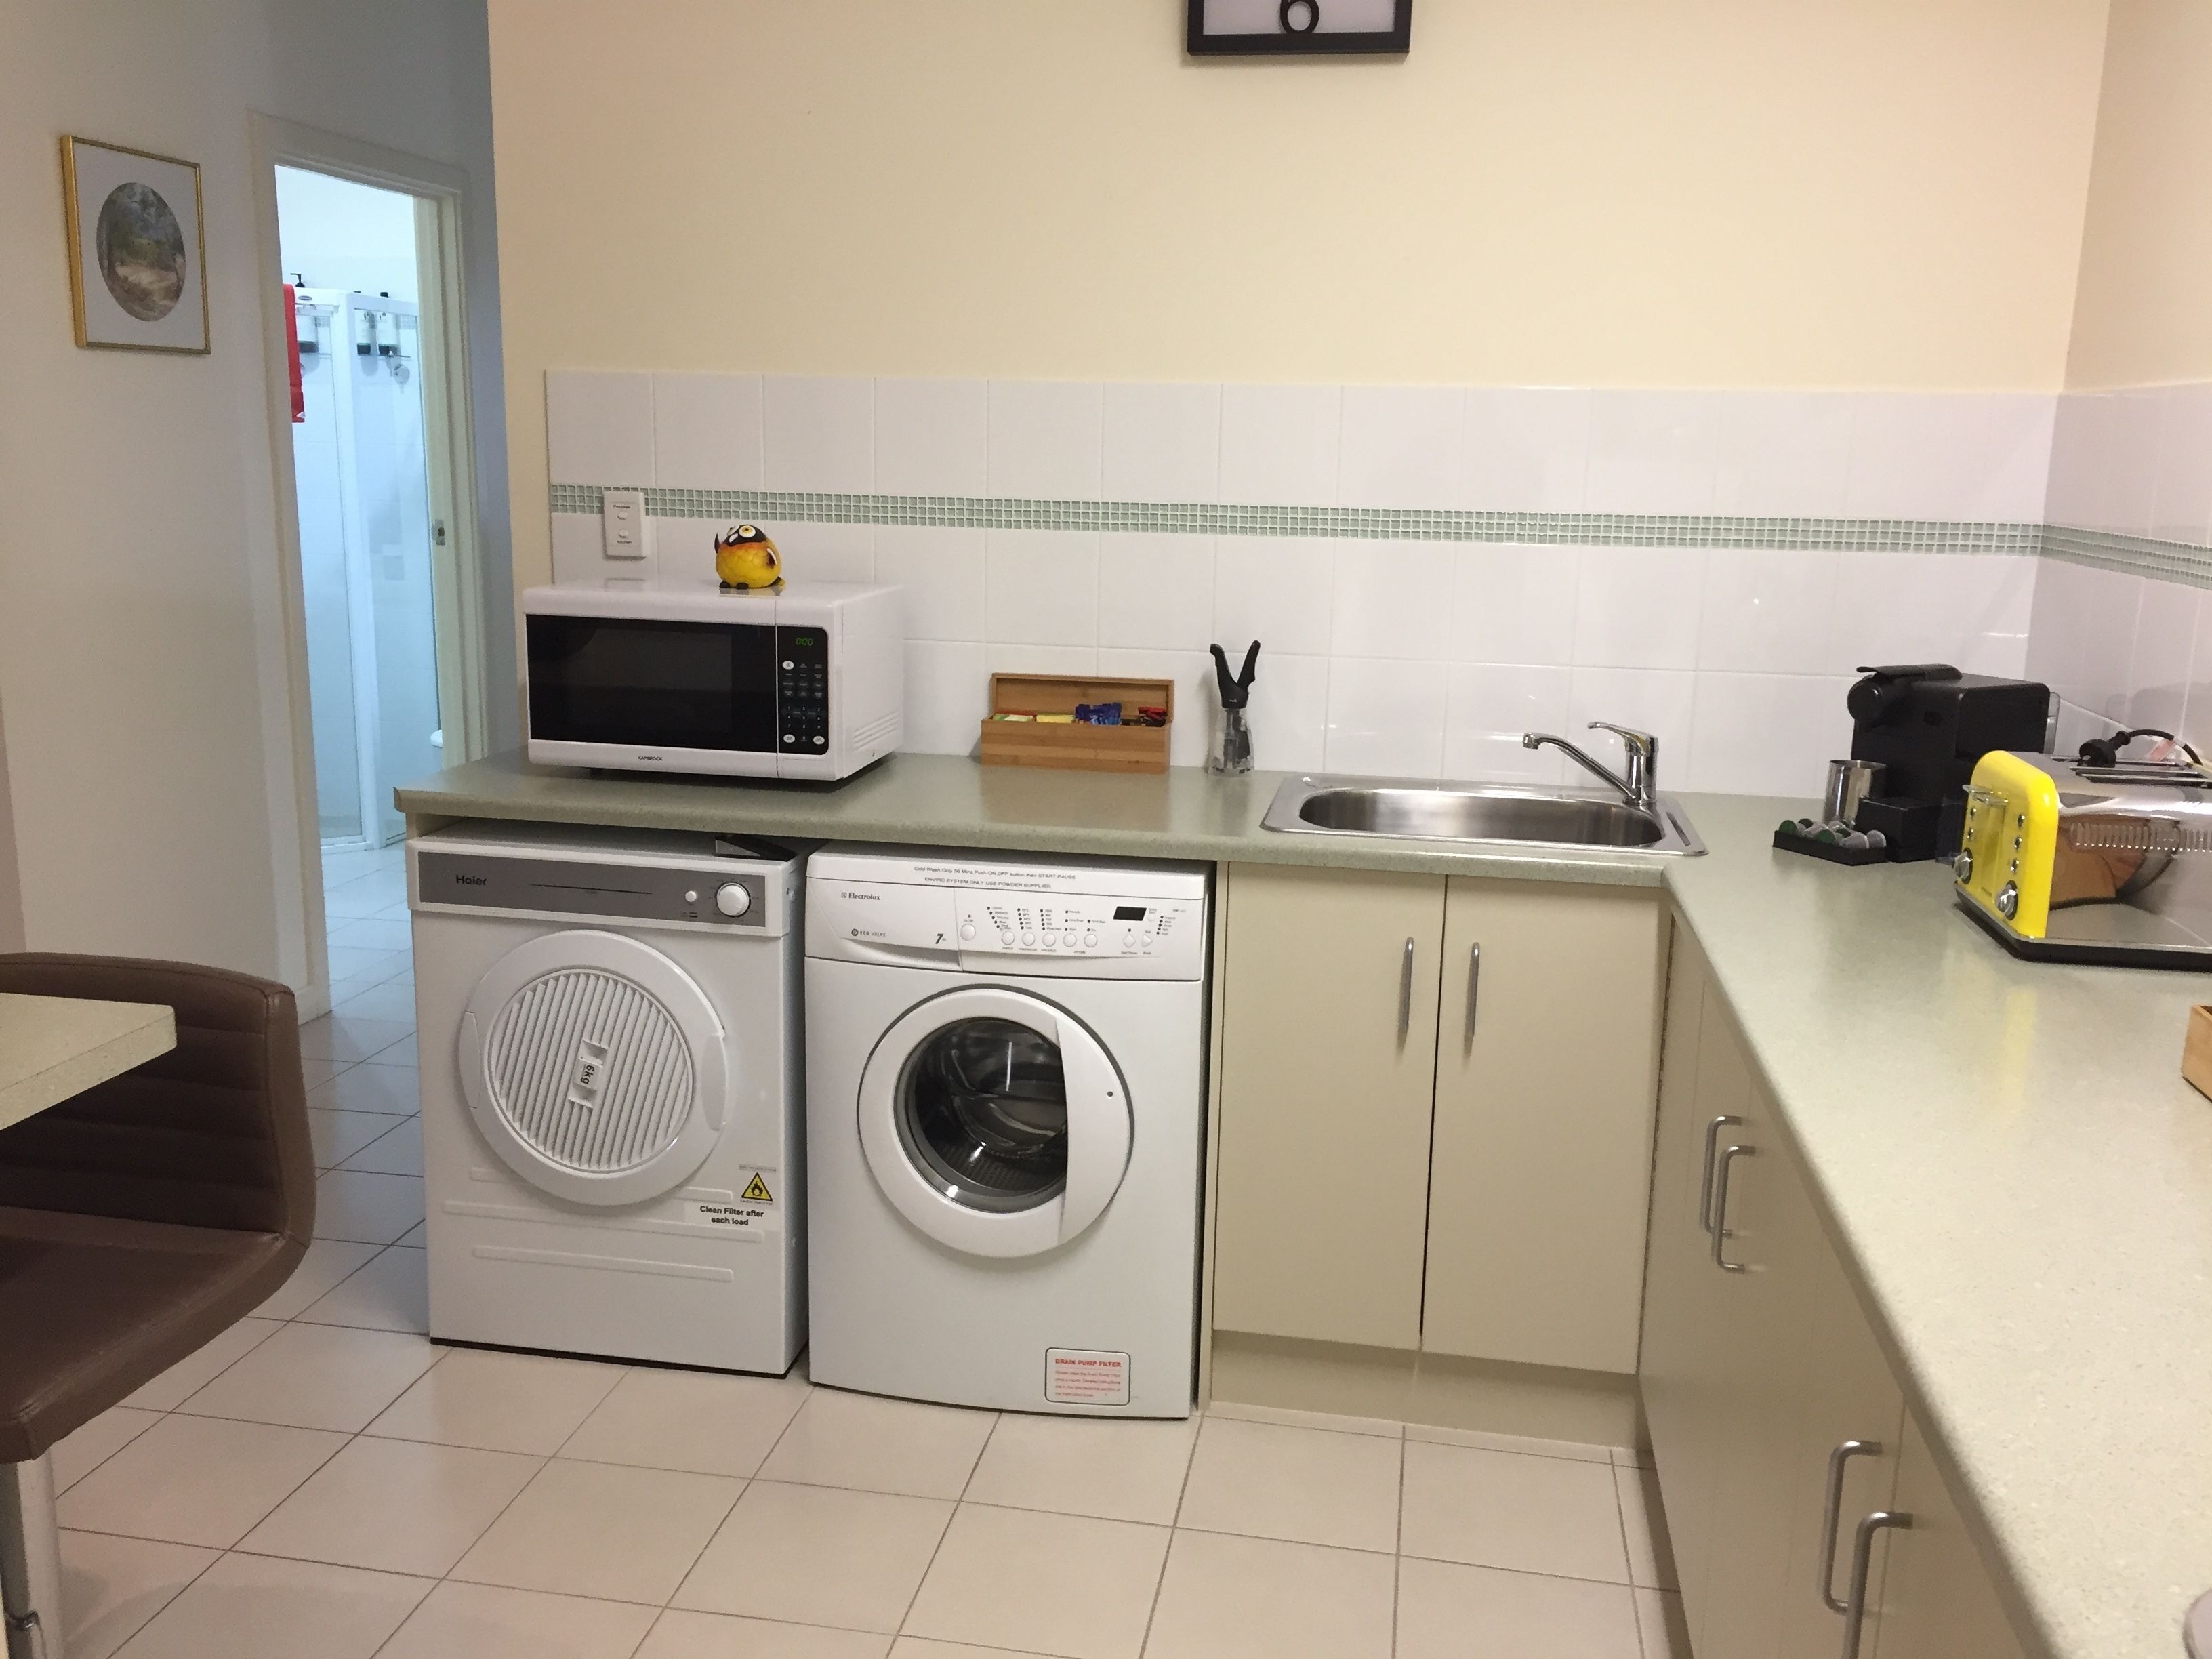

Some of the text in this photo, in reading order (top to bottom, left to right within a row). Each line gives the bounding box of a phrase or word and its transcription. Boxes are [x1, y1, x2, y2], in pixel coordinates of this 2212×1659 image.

[455, 875, 488, 886] Haier
[848, 893, 880, 901] Electrolux
[580, 1065, 595, 1085] 6kg
[699, 1206, 722, 1214] Clean
[724, 1208, 744, 1216] Filter
